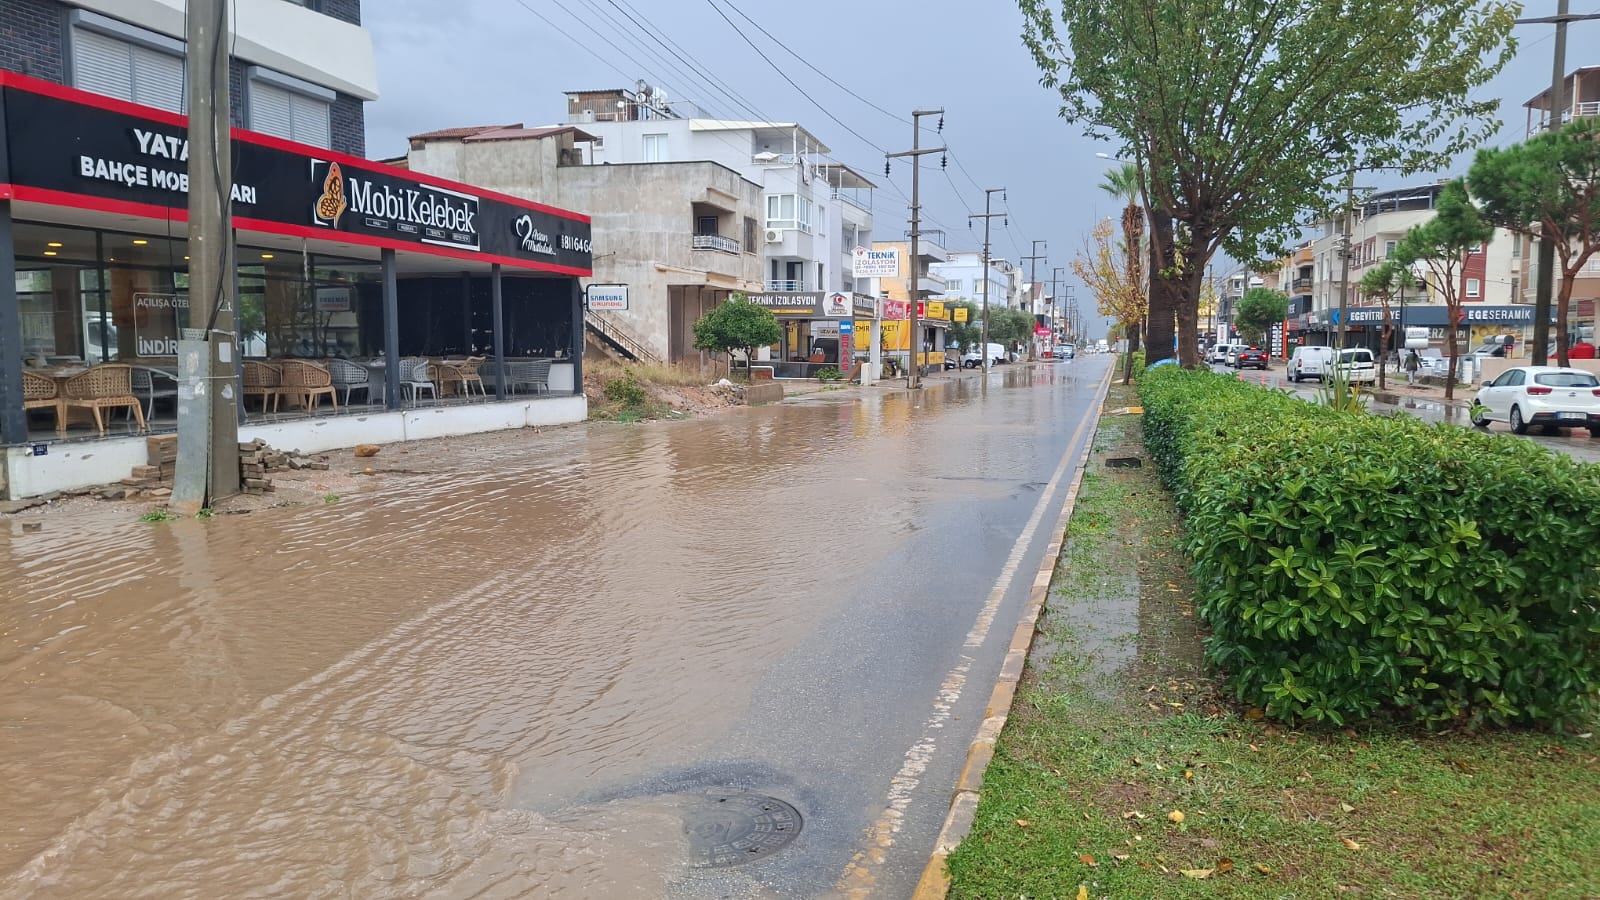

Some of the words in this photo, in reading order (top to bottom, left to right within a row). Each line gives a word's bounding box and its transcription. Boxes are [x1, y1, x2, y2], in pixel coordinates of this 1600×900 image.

[80, 155, 148, 187] BAHÇE
[137, 298, 170, 309] AÇILIŞA
[748, 295, 773, 305] TEKNİK
[775, 295, 816, 305] İZOLASYON
[139, 336, 179, 354] İNDİR
